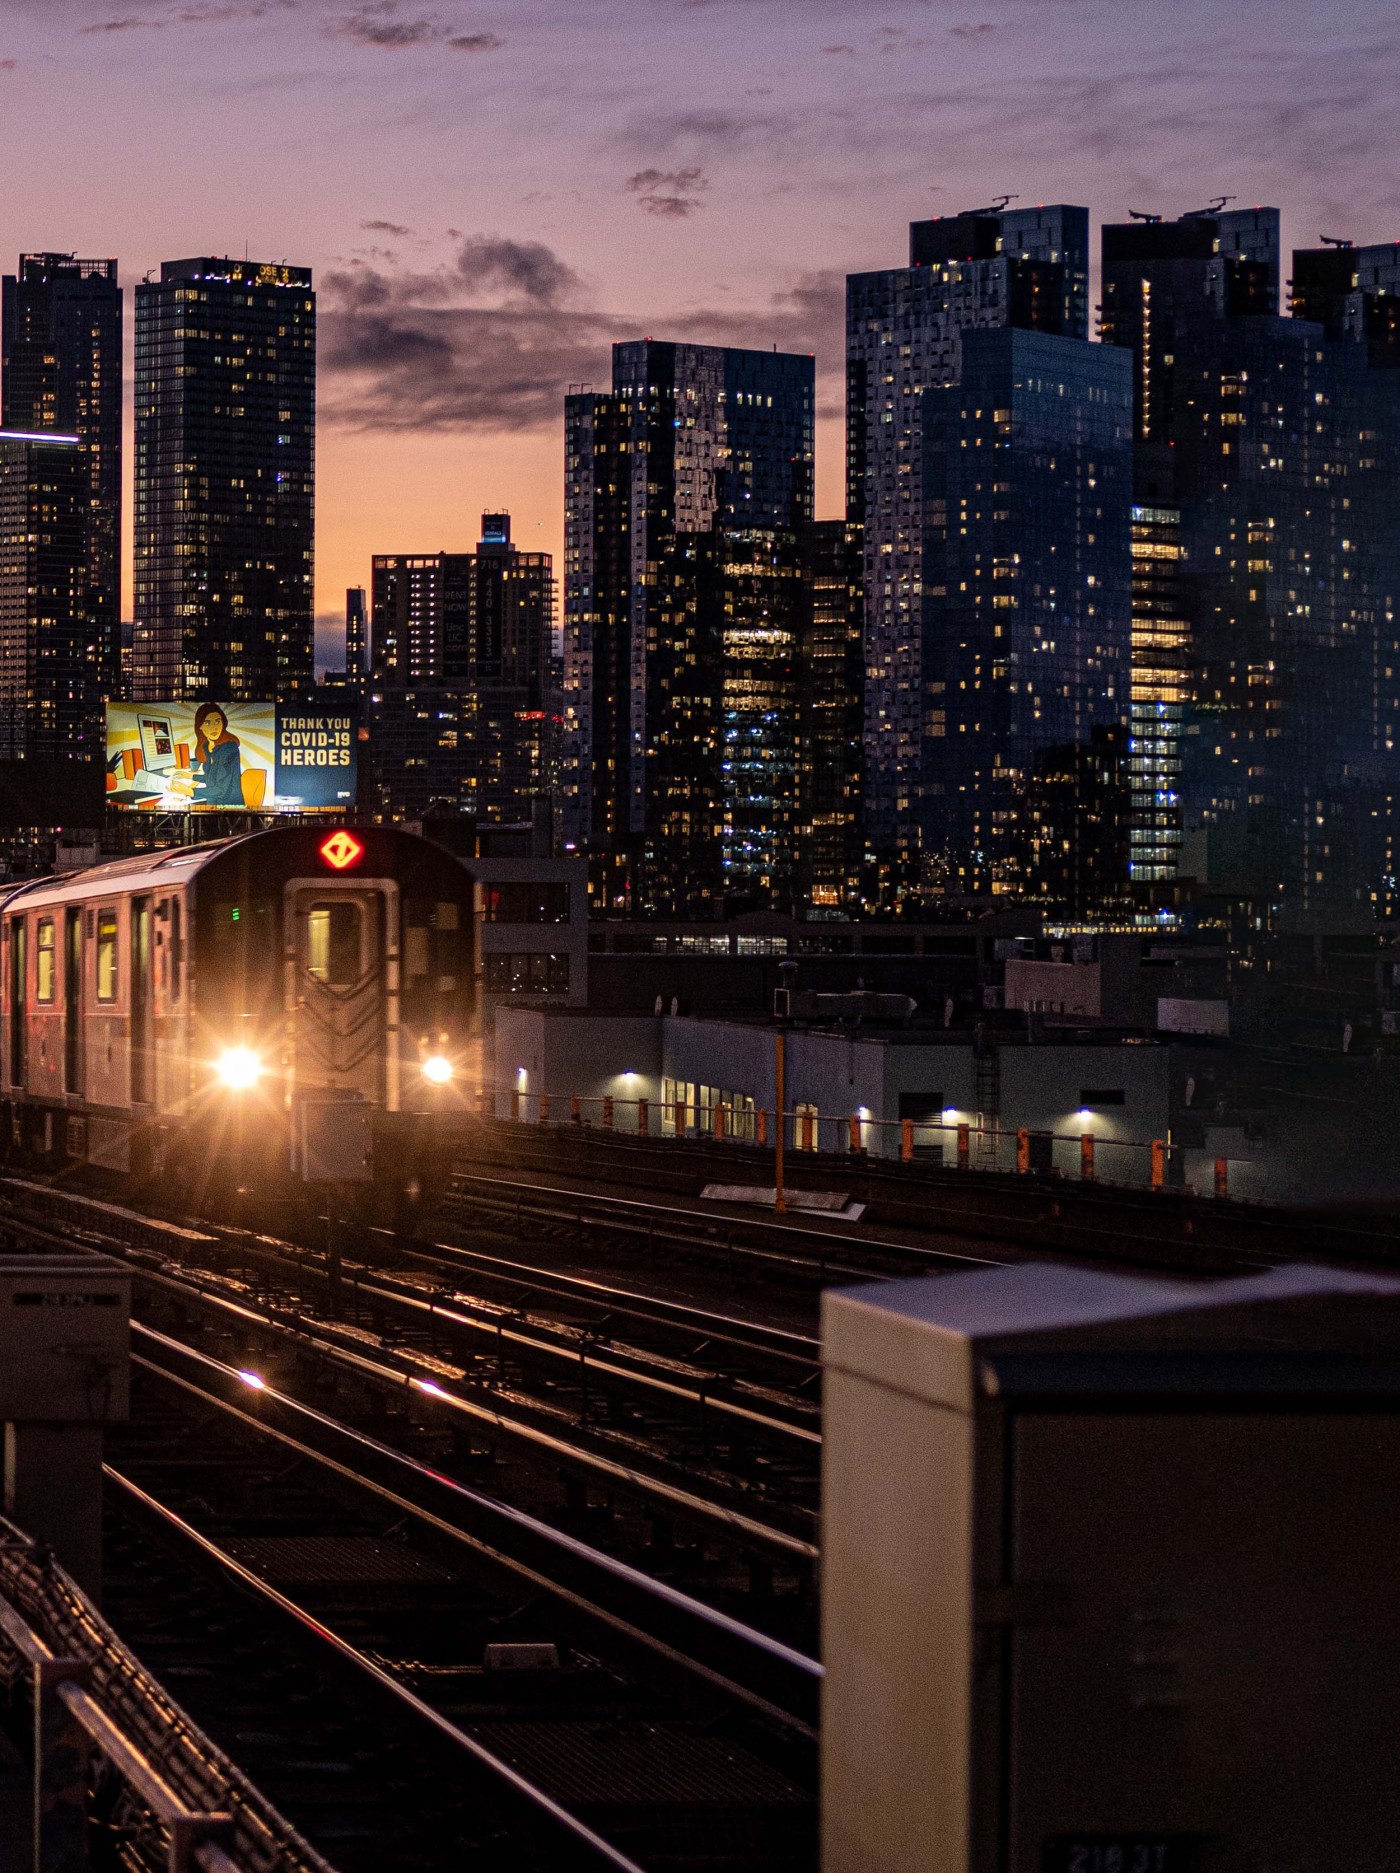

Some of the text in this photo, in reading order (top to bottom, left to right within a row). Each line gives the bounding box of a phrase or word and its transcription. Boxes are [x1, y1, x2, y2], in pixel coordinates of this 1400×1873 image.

[281, 718, 350, 729] THANK YOU
[281, 732, 350, 746] COVID-19
[281, 749, 350, 766] HEROES
